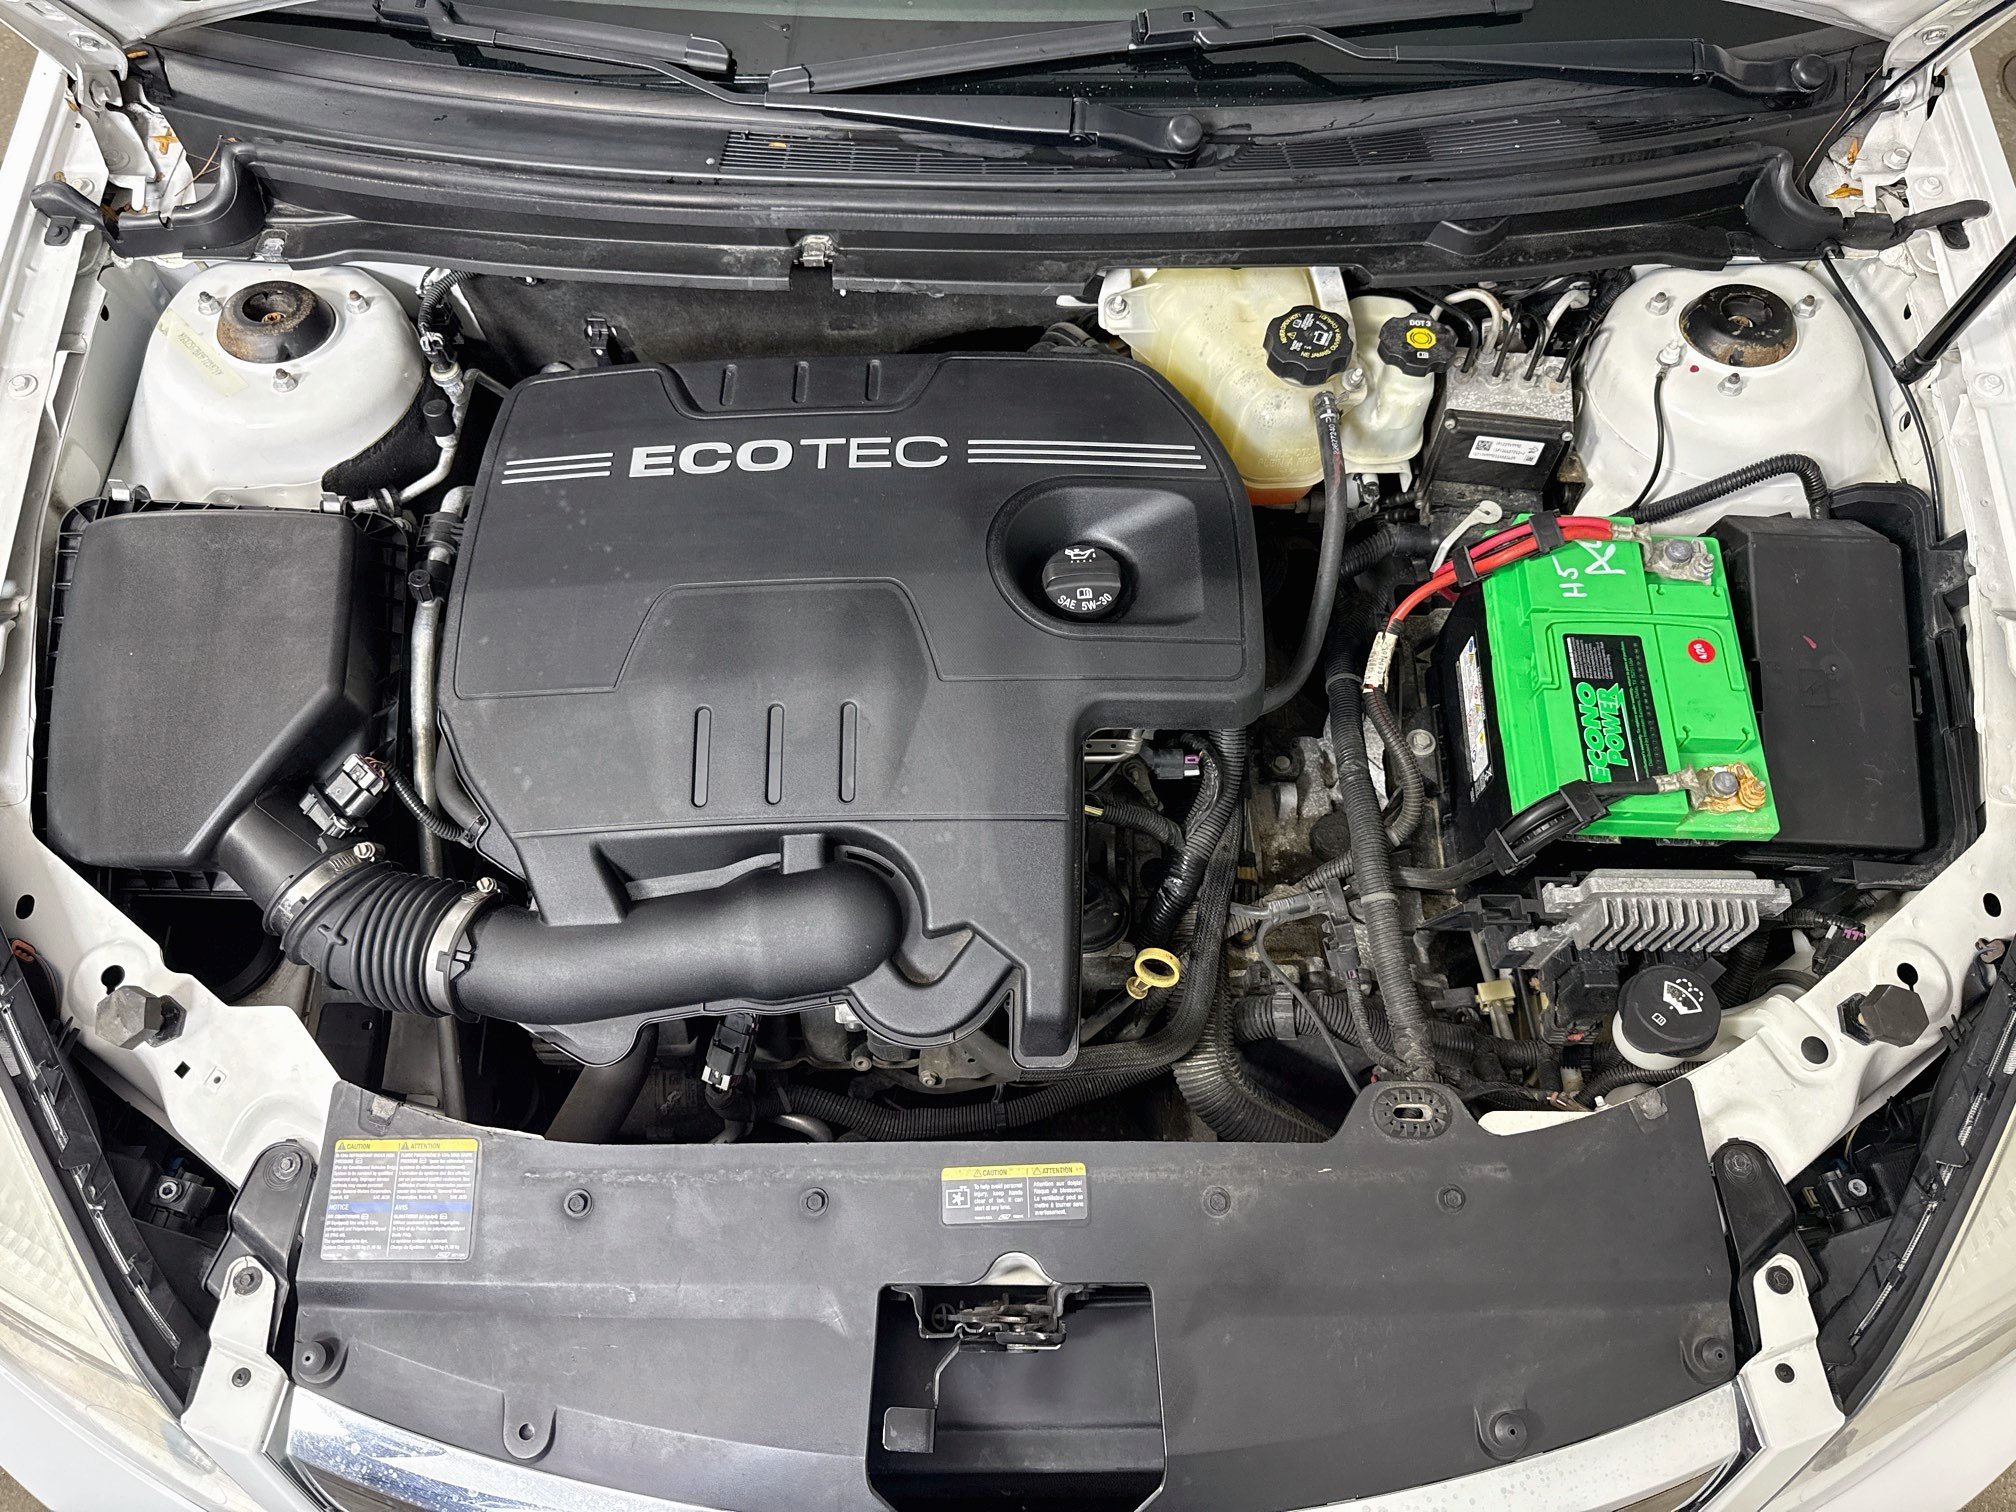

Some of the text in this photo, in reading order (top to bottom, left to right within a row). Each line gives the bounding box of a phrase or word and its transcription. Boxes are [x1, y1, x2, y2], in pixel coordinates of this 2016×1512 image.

[629, 436, 948, 478] ECOTEC
[1058, 593, 1112, 610] SAE 5W-30
[1576, 682, 1612, 783] ECONO
[1596, 682, 1629, 766] POWER
